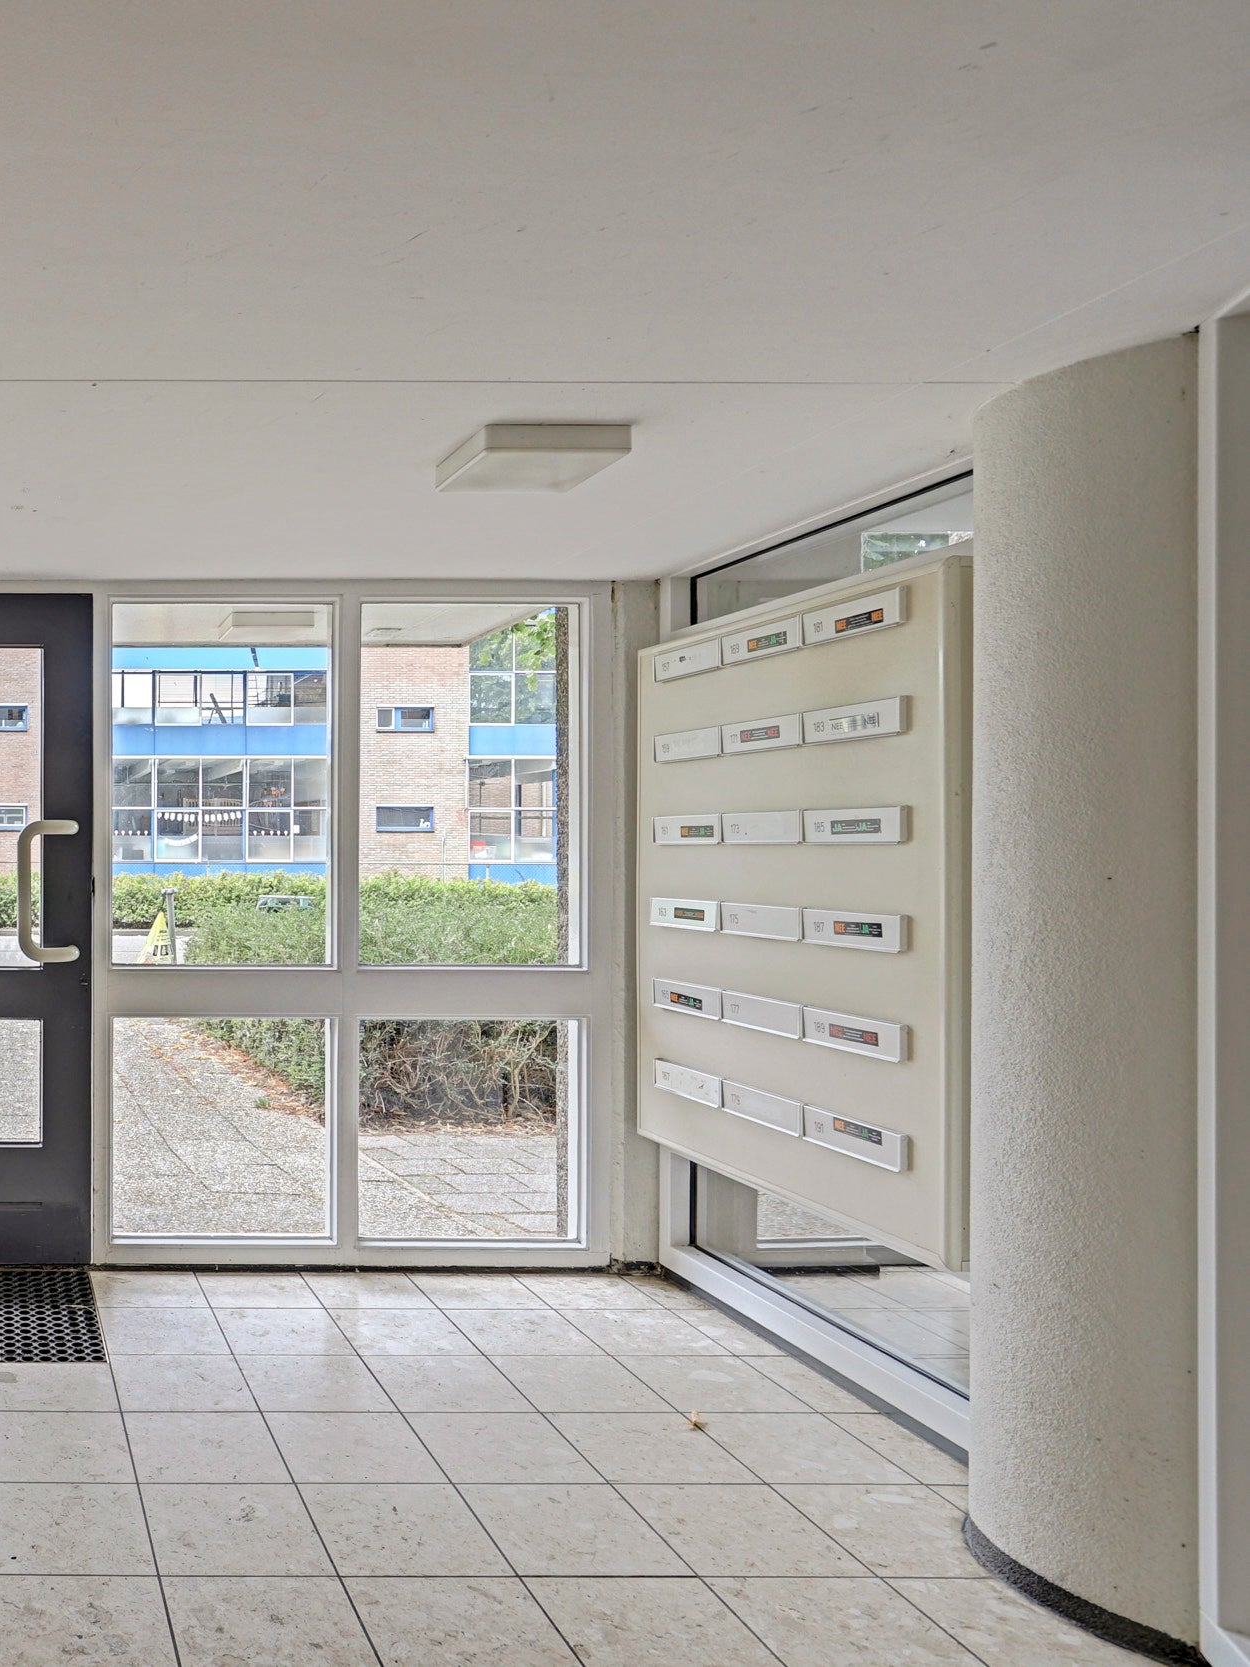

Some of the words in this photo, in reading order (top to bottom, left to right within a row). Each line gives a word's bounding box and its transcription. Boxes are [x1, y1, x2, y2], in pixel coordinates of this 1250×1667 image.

[835, 619, 847, 631] NEE
[871, 610, 883, 622] NEE
[813, 821, 825, 833] 185
[813, 921, 824, 933] 187
[834, 922, 846, 933] NEE
